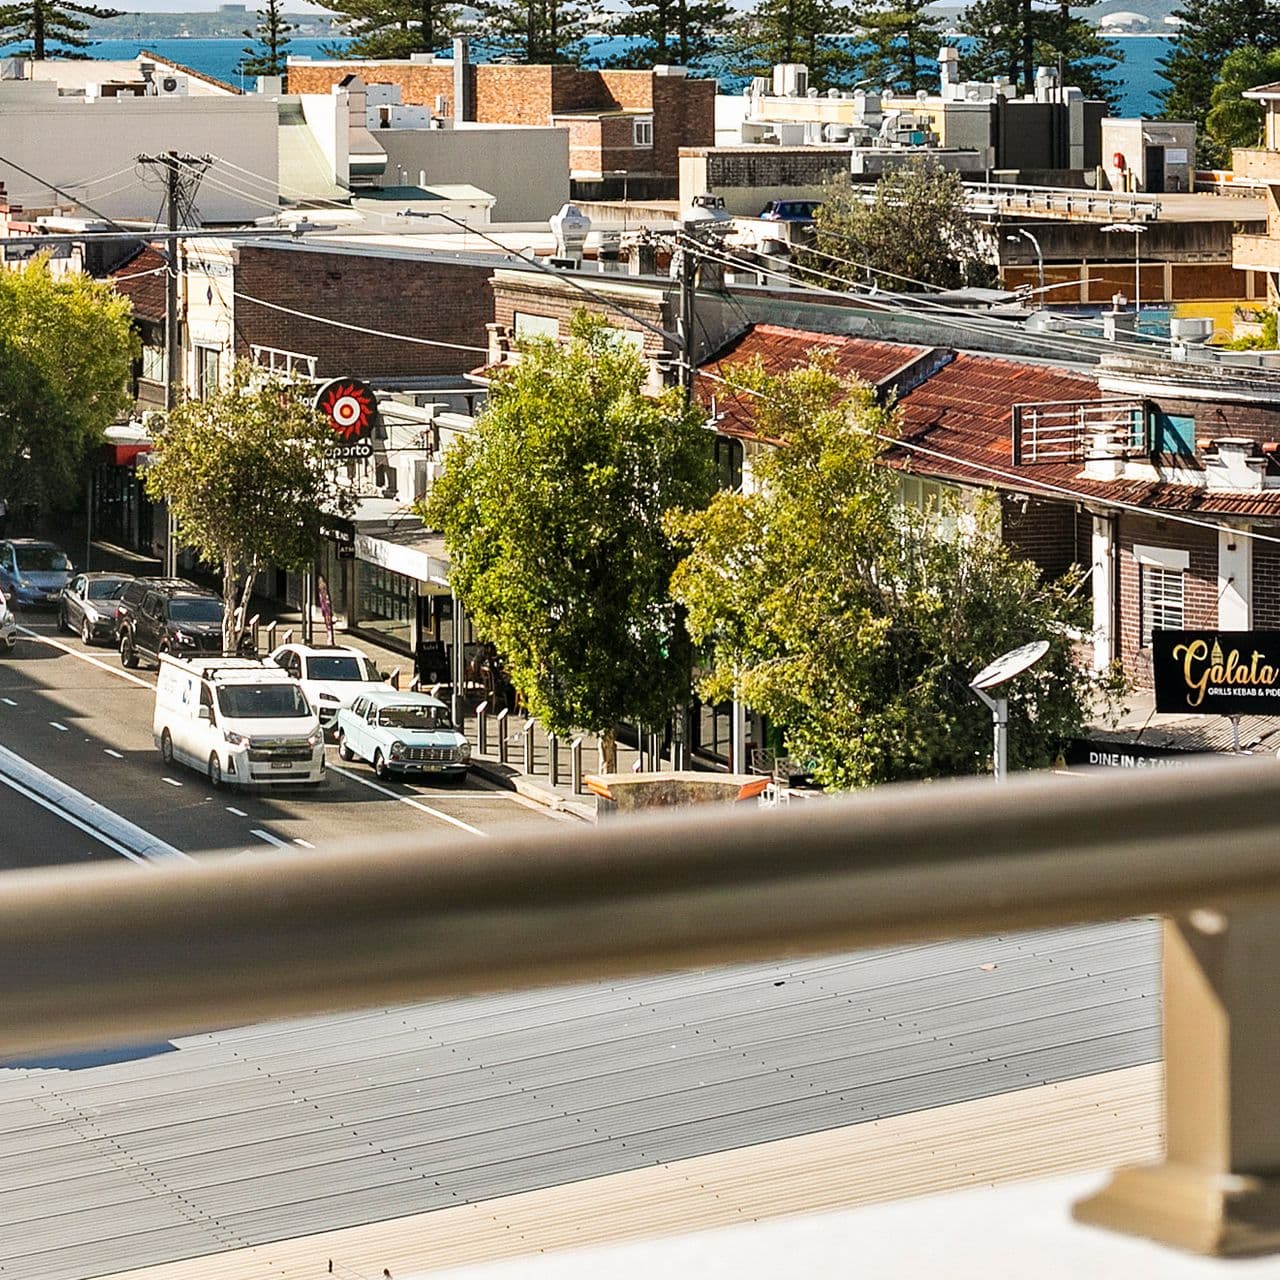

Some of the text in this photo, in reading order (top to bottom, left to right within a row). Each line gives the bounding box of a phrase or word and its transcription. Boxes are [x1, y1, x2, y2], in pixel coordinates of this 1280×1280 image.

[1172, 639, 1280, 707] Galata
[1207, 687, 1232, 697] GRILLS
[1233, 687, 1257, 697] KEBAB
[1258, 688, 1264, 697] &
[1089, 751, 1119, 767] DINE
[1120, 754, 1134, 768] IN
[1136, 756, 1146, 769] &
